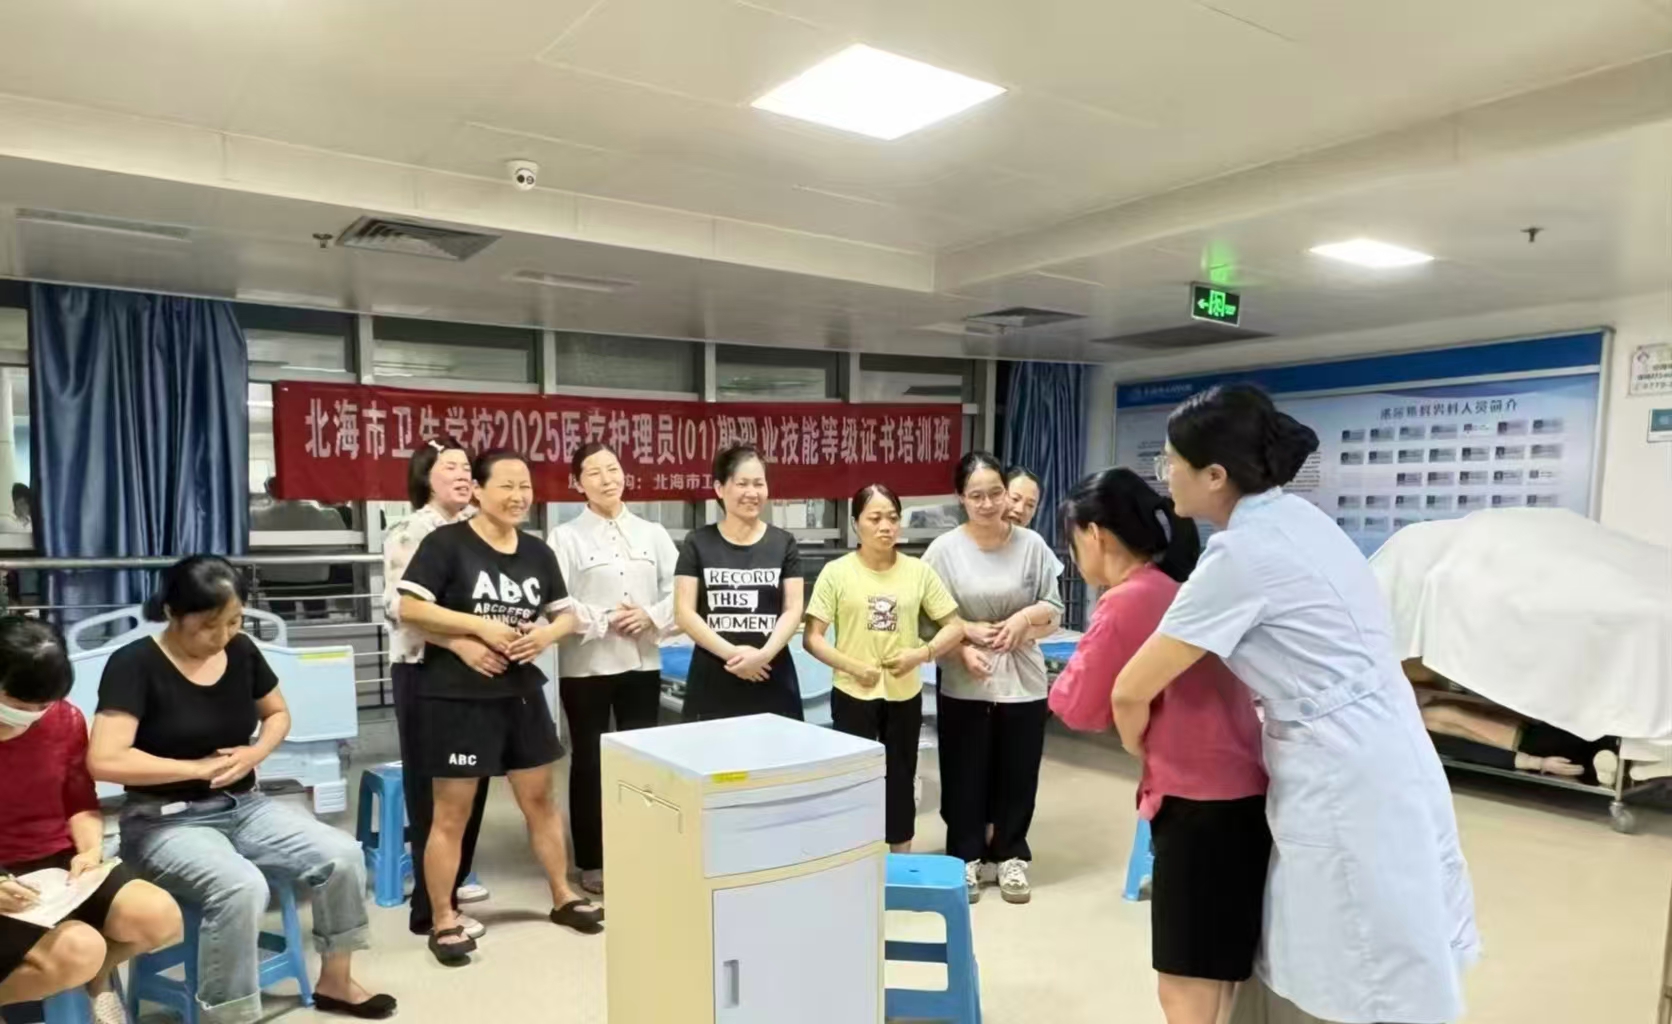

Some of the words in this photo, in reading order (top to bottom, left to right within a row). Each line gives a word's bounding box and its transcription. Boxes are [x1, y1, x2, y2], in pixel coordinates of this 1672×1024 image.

[710, 570, 776, 584] RECORD
[472, 570, 541, 607] ABC
[712, 592, 749, 606] THIS
[709, 616, 777, 630] MOMENT
[449, 753, 477, 766] ABC
